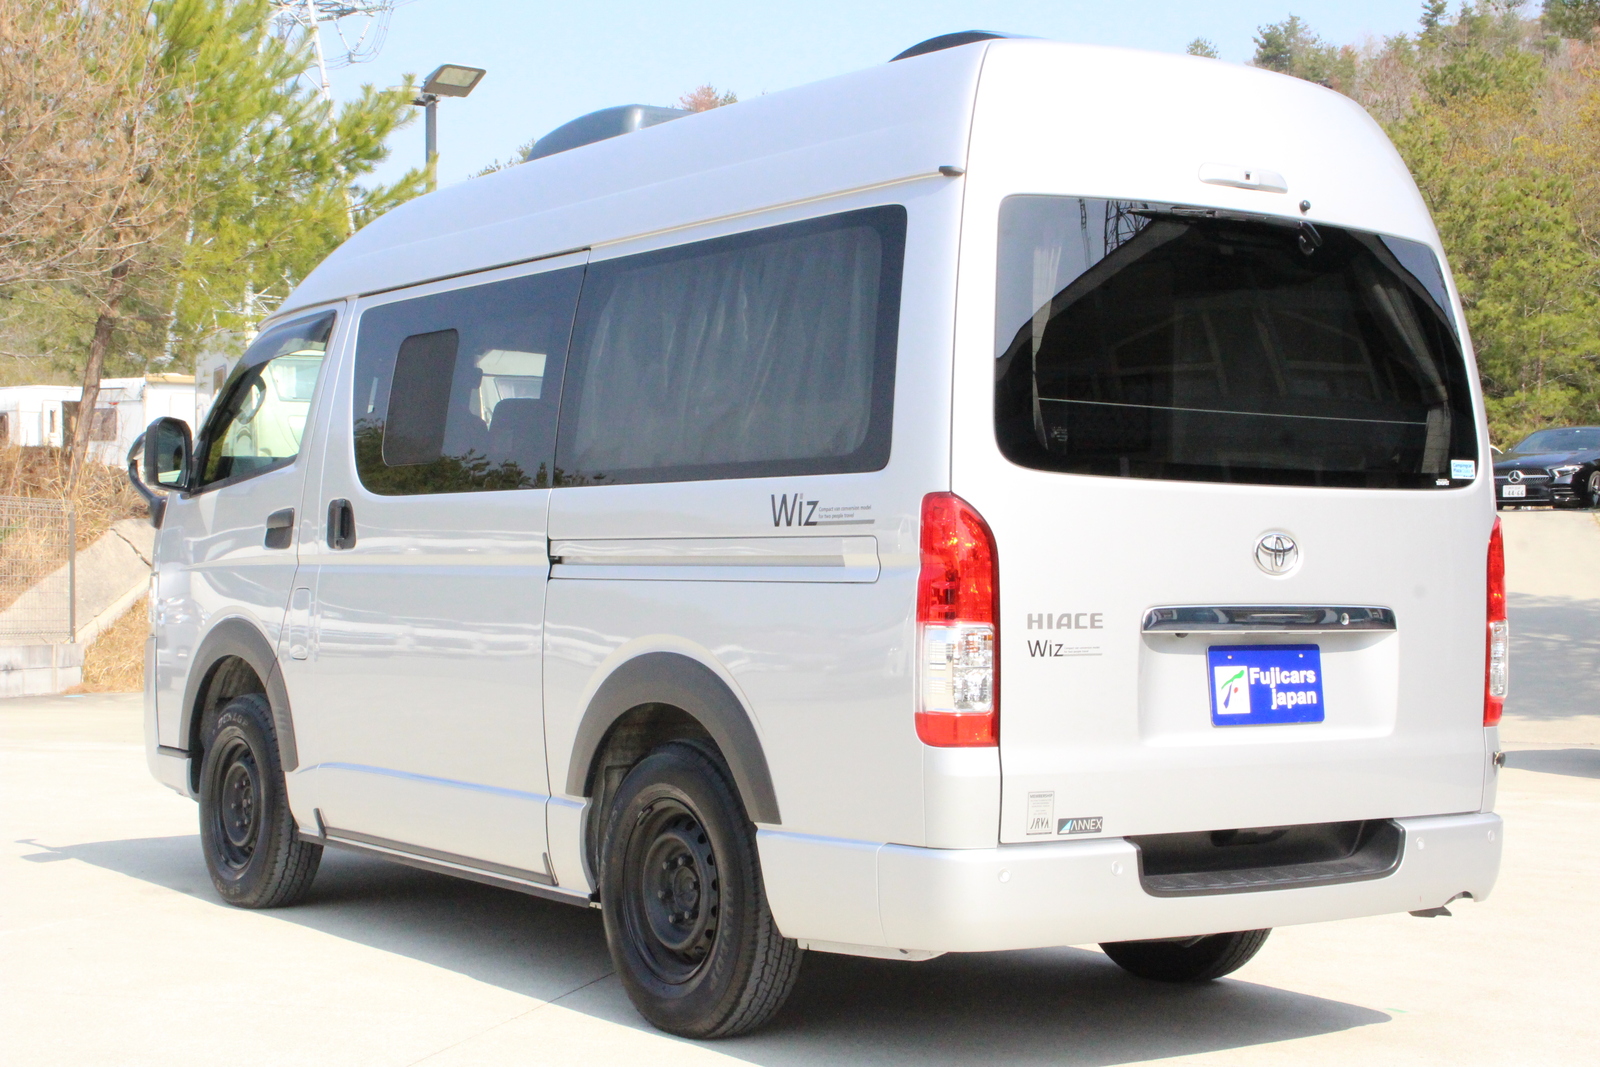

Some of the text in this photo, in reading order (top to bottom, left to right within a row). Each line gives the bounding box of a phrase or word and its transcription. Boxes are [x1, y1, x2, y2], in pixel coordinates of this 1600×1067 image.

[771, 493, 819, 527] Wiz
[1027, 612, 1103, 630] HIACE
[1027, 640, 1064, 657] Wiz
[1249, 667, 1316, 688] Fujicars
[1271, 688, 1317, 710] japan
[1030, 817, 1049, 829] JRVA
[1071, 819, 1103, 830] ANNEX
